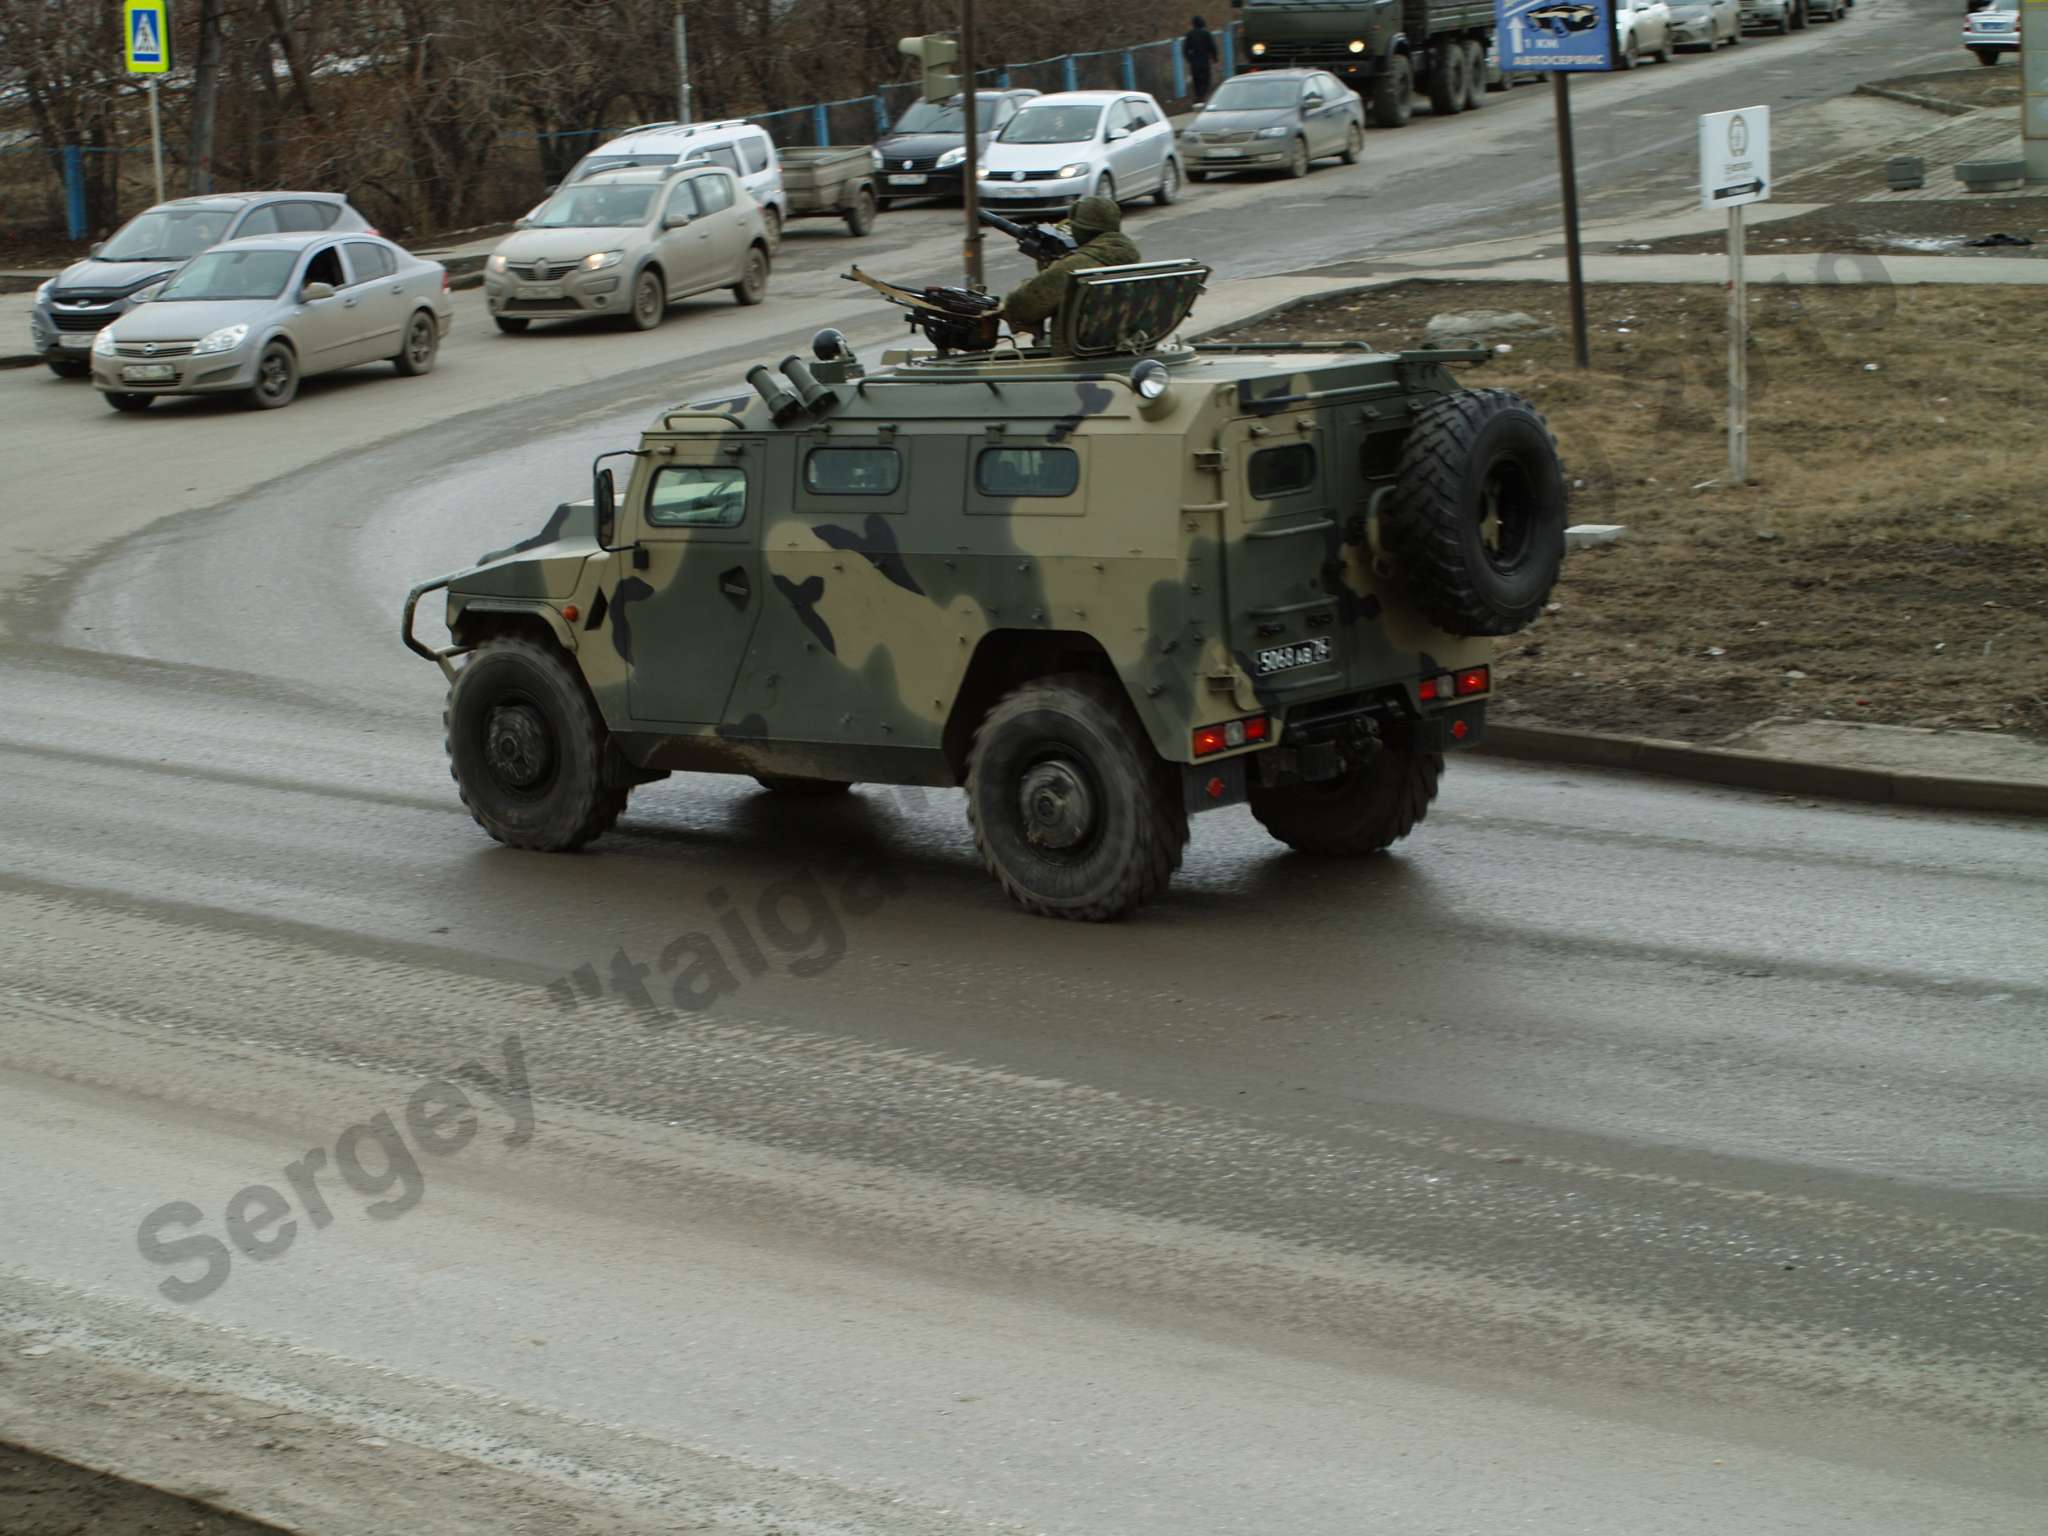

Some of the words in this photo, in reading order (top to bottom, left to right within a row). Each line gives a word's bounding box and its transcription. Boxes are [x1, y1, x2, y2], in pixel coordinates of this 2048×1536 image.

[1524, 38, 1532, 48] 1
[1512, 54, 1604, 65] АВТОСЕРВИС
[1260, 647, 1294, 672] 5068
